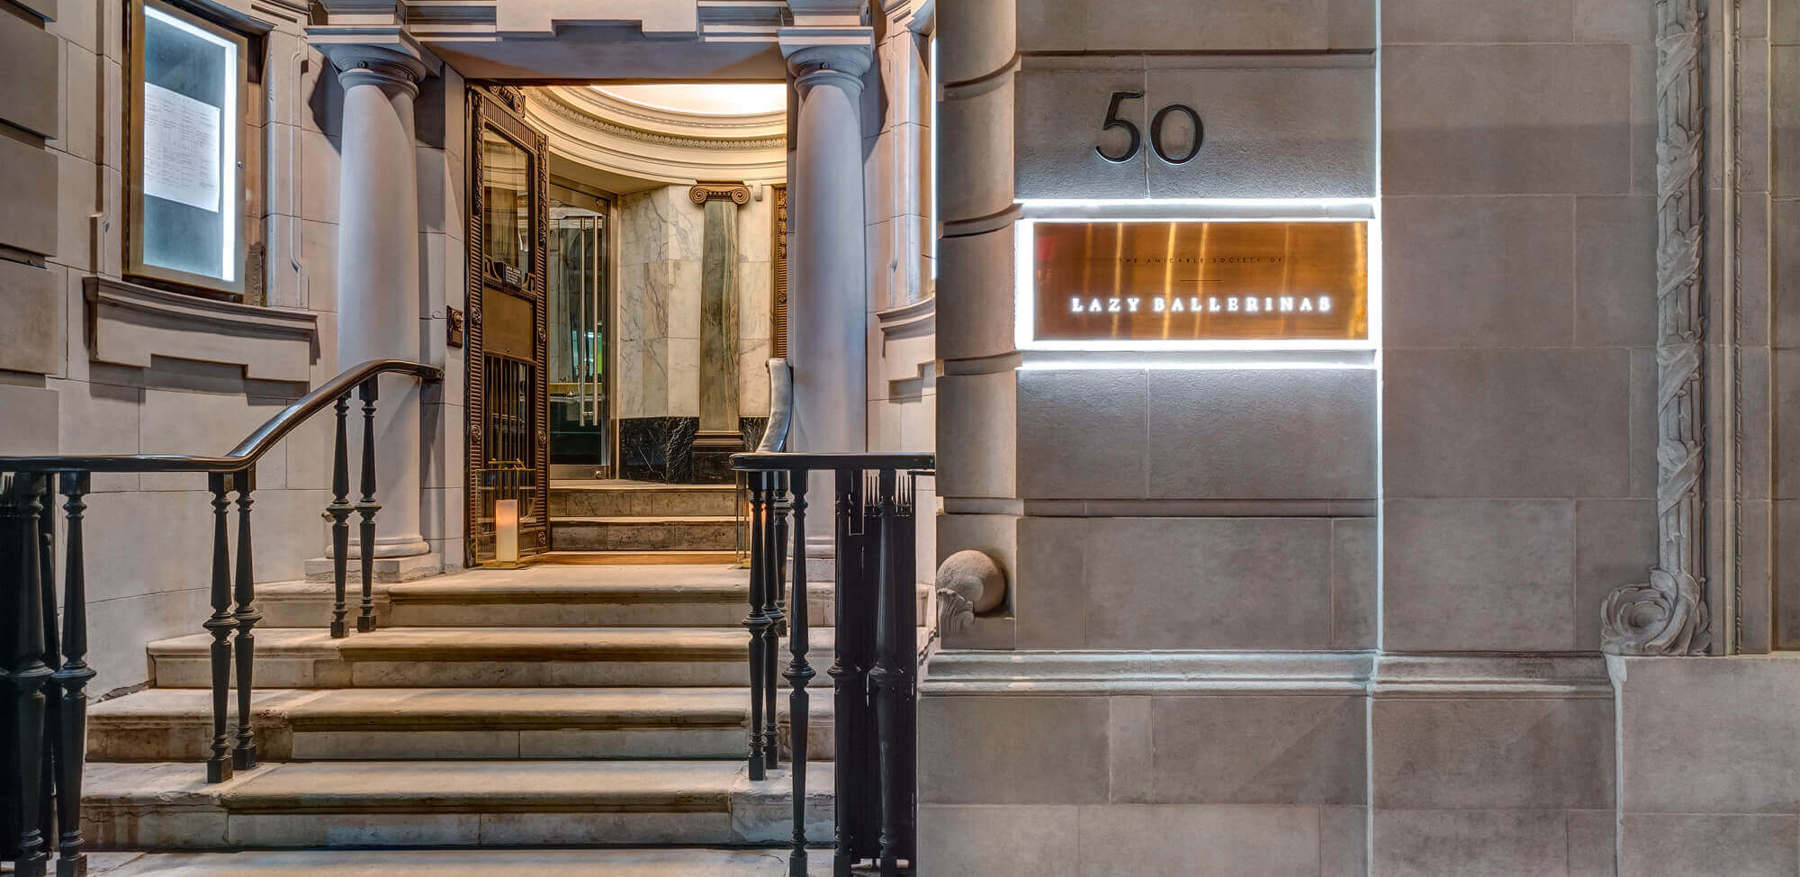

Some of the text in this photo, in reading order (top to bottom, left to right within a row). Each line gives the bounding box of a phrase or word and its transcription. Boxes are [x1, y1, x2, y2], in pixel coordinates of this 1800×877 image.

[1095, 90, 1204, 165] 50
[1070, 296, 1332, 313] LAZY BALLERINAS
